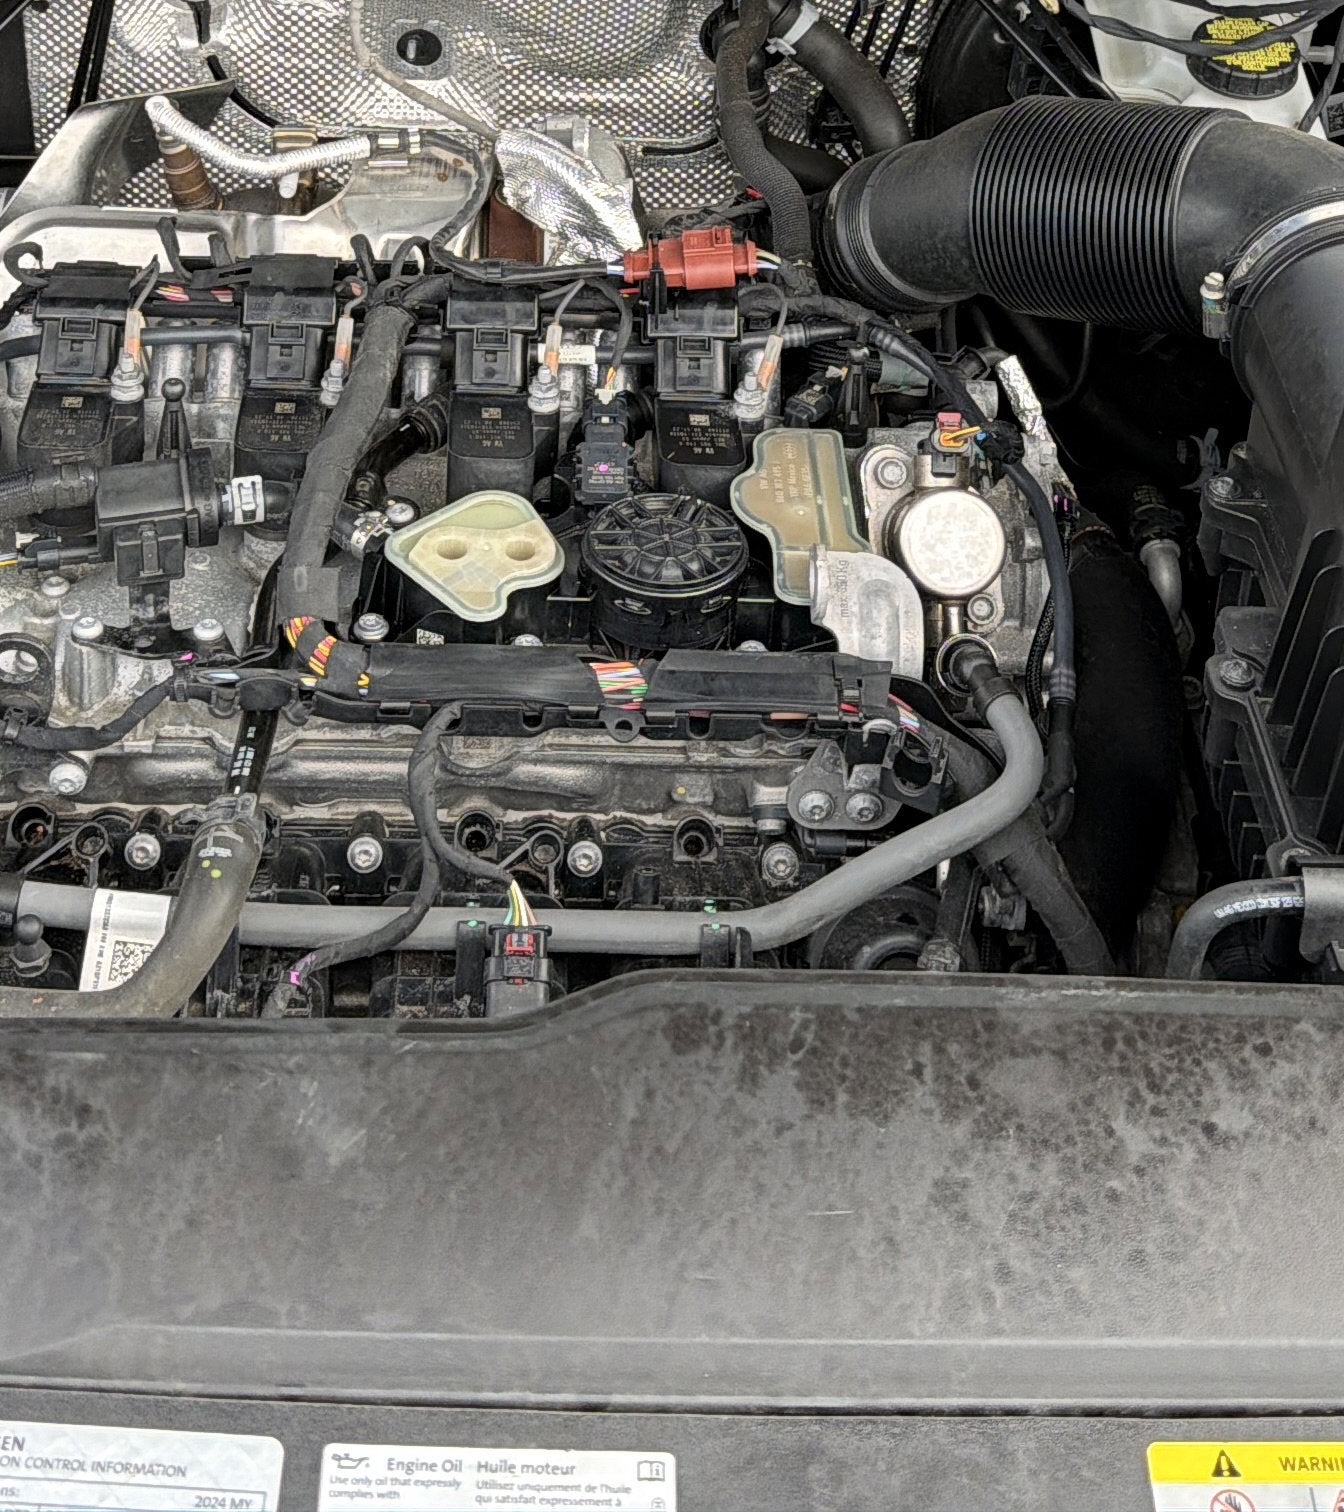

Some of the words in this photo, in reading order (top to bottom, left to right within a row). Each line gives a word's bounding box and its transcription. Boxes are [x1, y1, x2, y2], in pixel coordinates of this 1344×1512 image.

[24, 1455, 87, 1473] CONTROL
[90, 1460, 188, 1478] INFORMATION
[387, 1457, 438, 1475] Engine
[441, 1459, 463, 1473] Oil
[476, 1459, 517, 1475] Huile
[520, 1463, 576, 1476] moteur
[329, 1474, 350, 1485] Use
[351, 1475, 373, 1488] only
[375, 1476, 388, 1486] oil
[390, 1476, 412, 1487] that
[413, 1477, 462, 1490] expressly
[585, 1482, 598, 1494] de
[194, 1494, 227, 1509] 2024
[229, 1497, 253, 1510] MY
[376, 1489, 401, 1500] with
